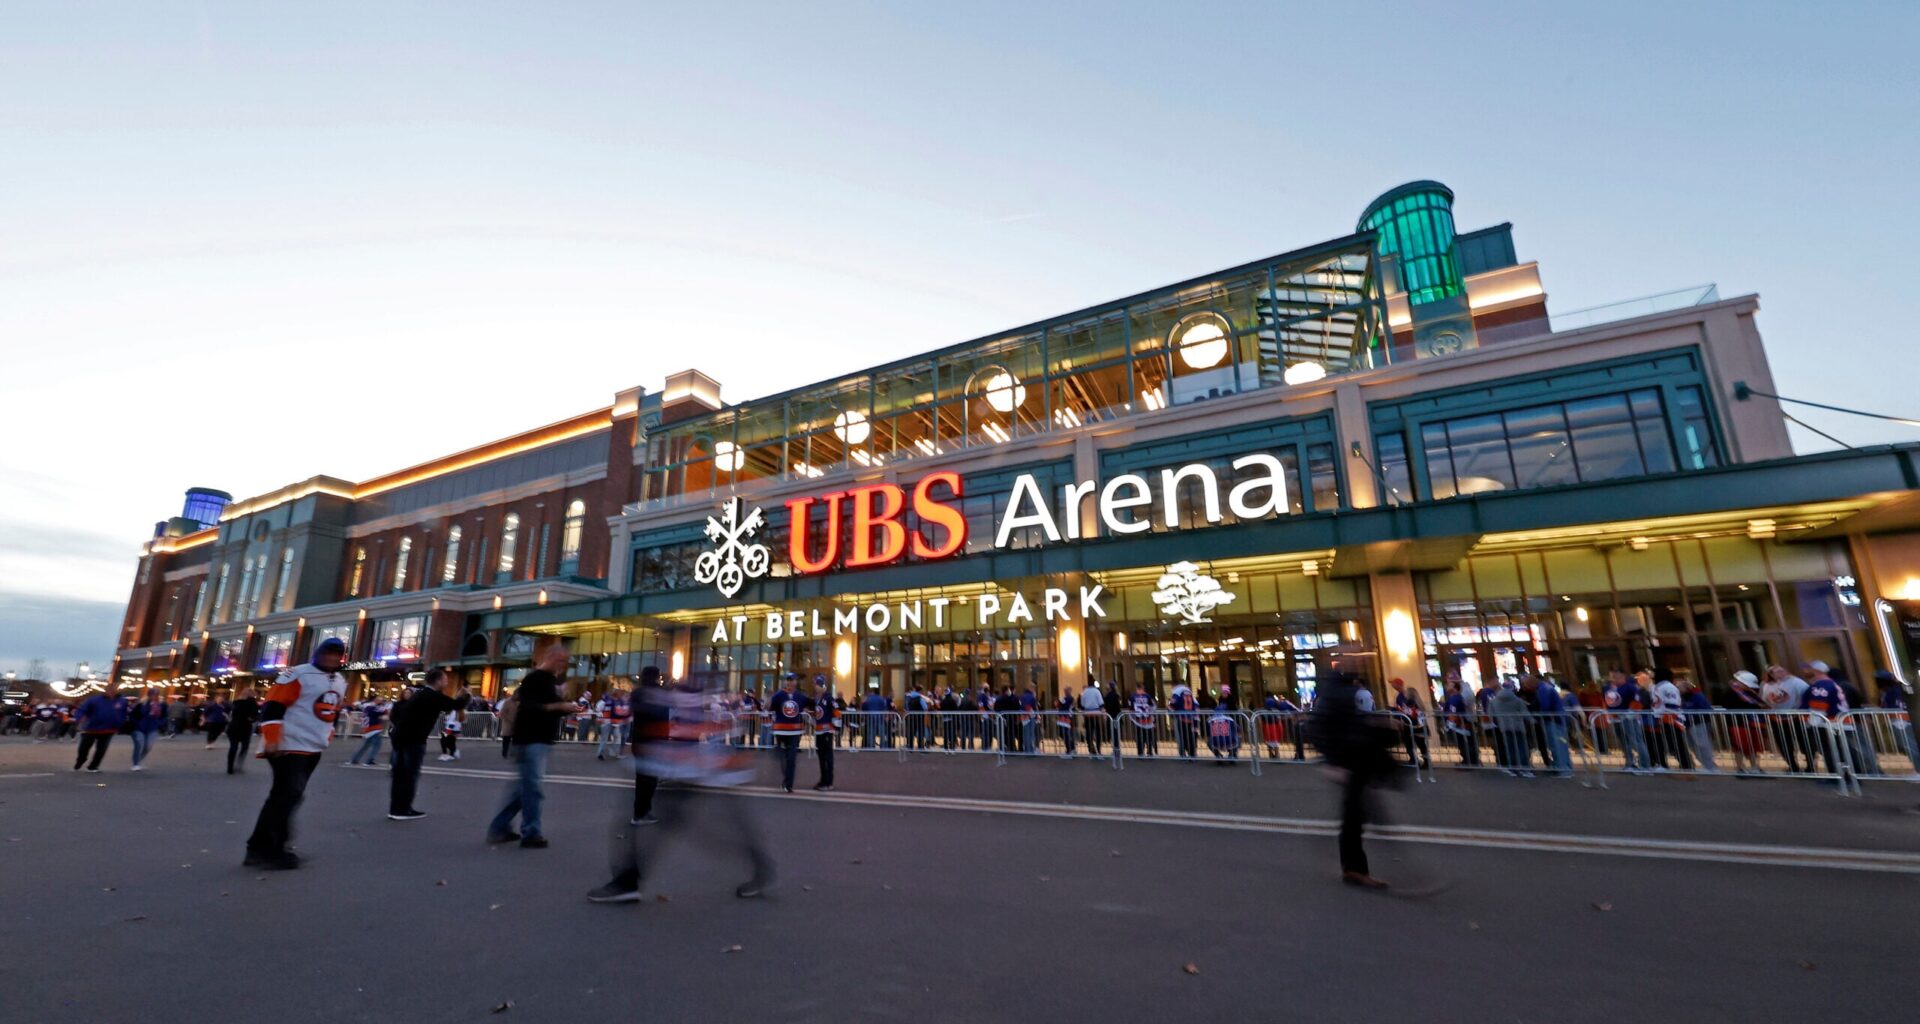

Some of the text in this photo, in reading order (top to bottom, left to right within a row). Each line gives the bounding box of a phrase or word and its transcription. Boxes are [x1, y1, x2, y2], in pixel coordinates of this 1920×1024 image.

[784, 453, 1290, 574] UBS Arena
[711, 584, 1107, 643] AT BELMONT PARK
